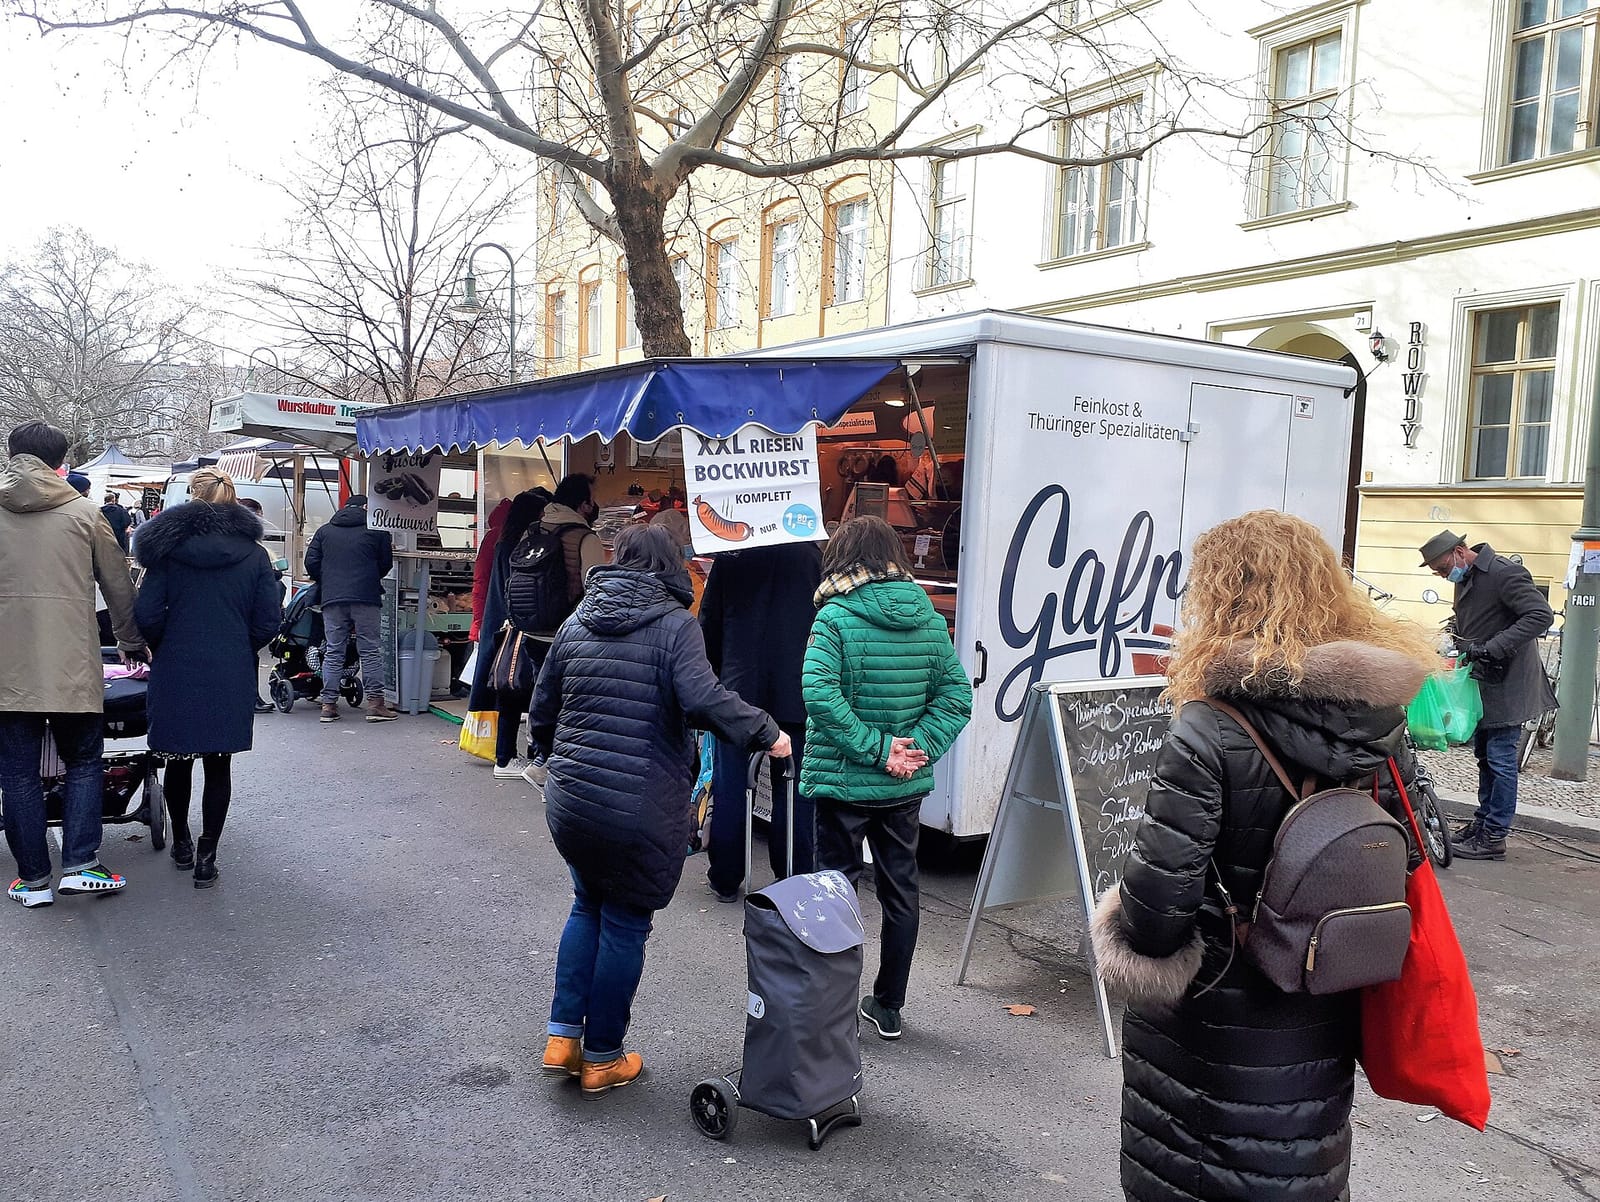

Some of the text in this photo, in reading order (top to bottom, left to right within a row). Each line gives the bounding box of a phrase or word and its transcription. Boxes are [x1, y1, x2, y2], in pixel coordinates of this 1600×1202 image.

[1356, 317, 1366, 326] 71
[1400, 321, 1424, 446] ROWDY
[277, 399, 336, 416] Wurstkultur.
[1073, 396, 1143, 418] Feinkost &
[1028, 412, 1181, 441] Thüringer Spezialitäten
[697, 434, 804, 456] XXL RIESEN
[694, 459, 810, 481] BOCKWURST
[735, 490, 792, 504] KOMPLETT
[372, 508, 434, 532] Blutwurst
[759, 523, 778, 535] NUR
[1572, 595, 1596, 606] FACH
